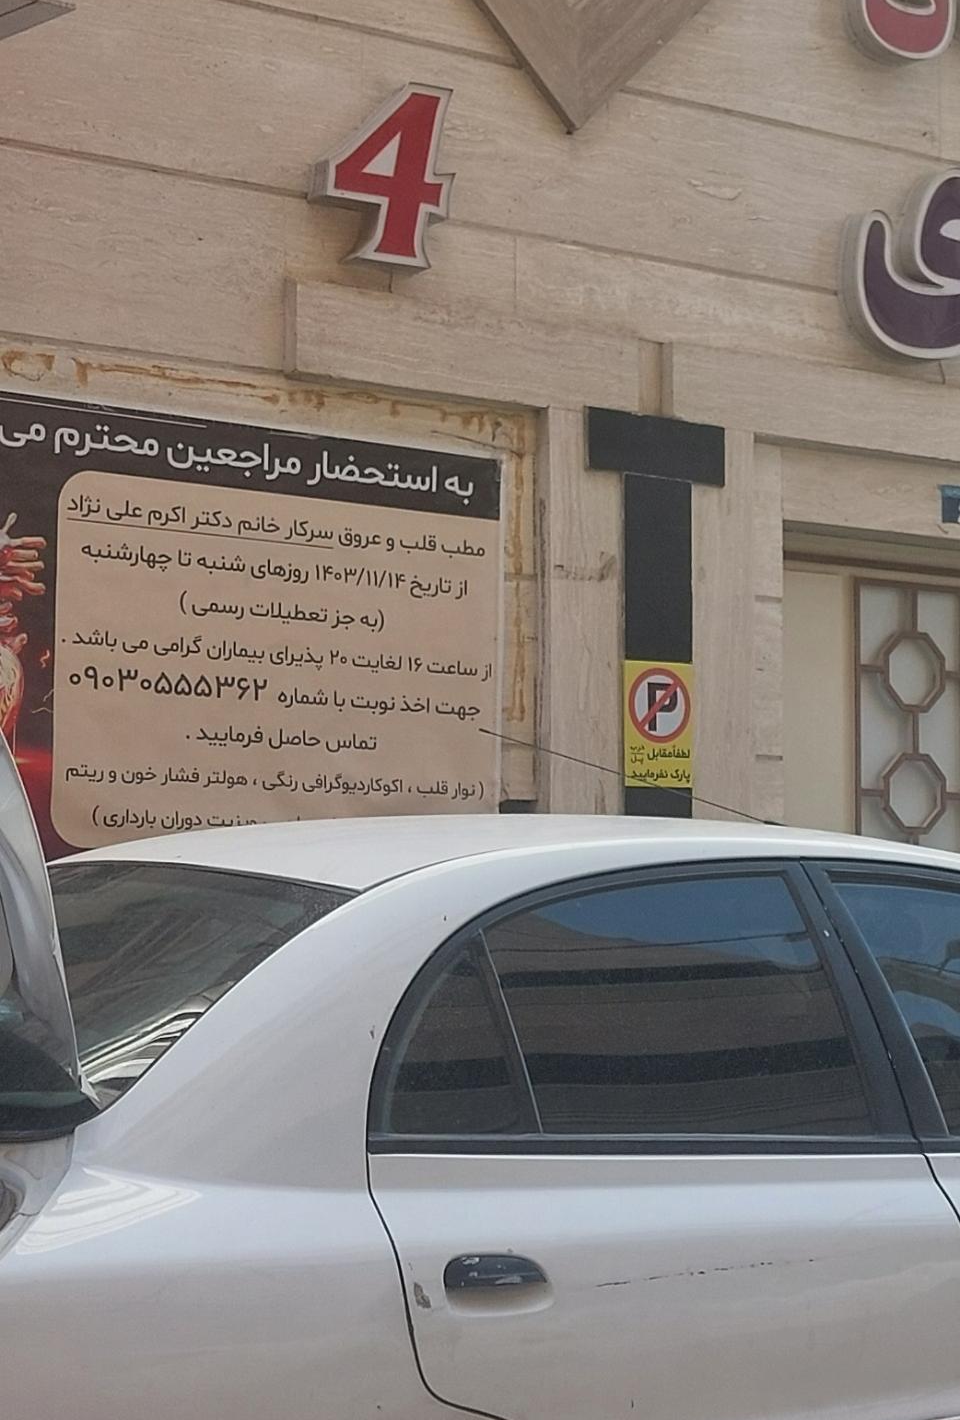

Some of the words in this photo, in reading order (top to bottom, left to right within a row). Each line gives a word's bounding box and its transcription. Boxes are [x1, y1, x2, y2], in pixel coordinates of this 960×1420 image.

[325, 82, 456, 269] 4
[54, 424, 160, 457] محترم
[166, 441, 302, 480] مراجعین
[306, 450, 438, 493] استحضار
[444, 474, 475, 506] به
[67, 494, 101, 518] نژاد
[106, 500, 142, 520] علی
[147, 506, 186, 525] اکرم
[190, 510, 232, 530] دکتر
[237, 515, 281, 535] خانم
[284, 519, 334, 543] سرکار
[338, 528, 381, 550] عروق
[386, 536, 395, 552] و
[399, 534, 437, 555] قلب
[440, 540, 486, 559] مطب
[81, 543, 173, 572] چهارشنبه
[177, 548, 192, 567] تا
[196, 554, 246, 574] شنبه
[250, 558, 309, 583] روزهای
[409, 575, 452, 599] تاریخ
[455, 580, 468, 600] از
[249, 601, 328, 625] تعطیلات
[331, 609, 356, 630] جز
[122, 636, 149, 654] می
[153, 635, 203, 658] گرامی
[206, 640, 265, 664] بیماران
[269, 645, 324, 671] پذیرای
[329, 649, 348, 665] ۲۰
[351, 654, 402, 674] لغایت
[407, 656, 423, 673] ۱۶
[426, 660, 478, 678] ساعت
[481, 663, 493, 682] از
[69, 664, 268, 701] ۰۹۰۳۰۵۵۵۳۶۲
[277, 687, 329, 709] شماره
[333, 690, 346, 712] با
[350, 695, 396, 715] نوبت
[399, 694, 430, 714] اخذ
[434, 701, 481, 721] جهت
[268, 728, 321, 750] حاصل
[325, 732, 377, 753] تماس
[65, 764, 104, 783] ریتم
[108, 769, 117, 783] و
[121, 766, 157, 784] خون
[161, 766, 200, 786] فشار
[203, 770, 248, 789] هولتر
[302, 773, 403, 797] اکوکاردیوگرافی
[161, 810, 203, 830] دوران
